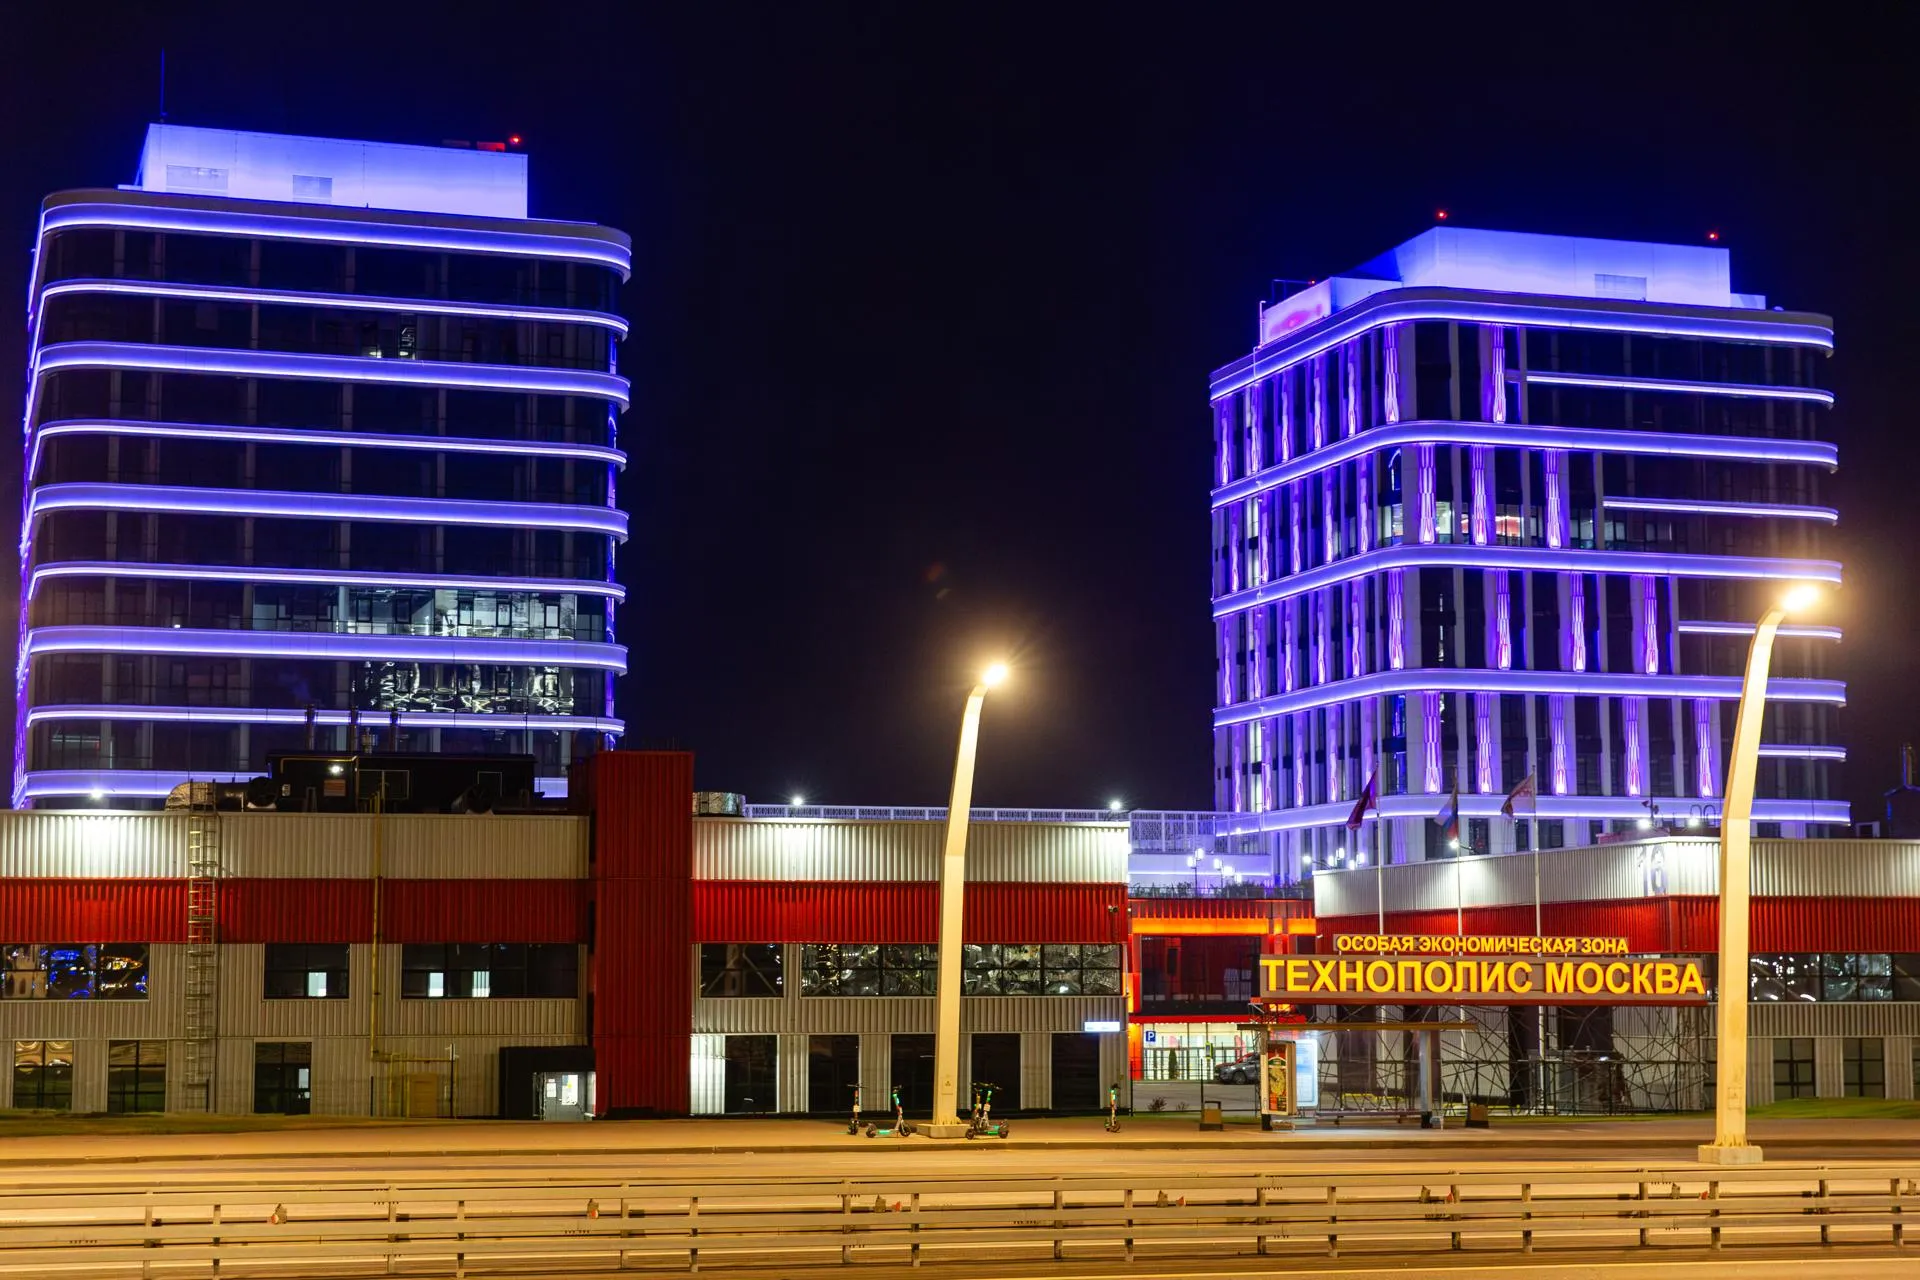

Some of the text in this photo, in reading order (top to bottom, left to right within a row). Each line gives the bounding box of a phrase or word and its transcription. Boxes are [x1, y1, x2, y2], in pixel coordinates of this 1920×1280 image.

[1336, 935, 1629, 954] ОСОБАЯ ЭКОНОМИЧЕСКАЯ ЗОНА
[1260, 959, 1706, 995] ТЕХНОПОЛИС МОСКВА
